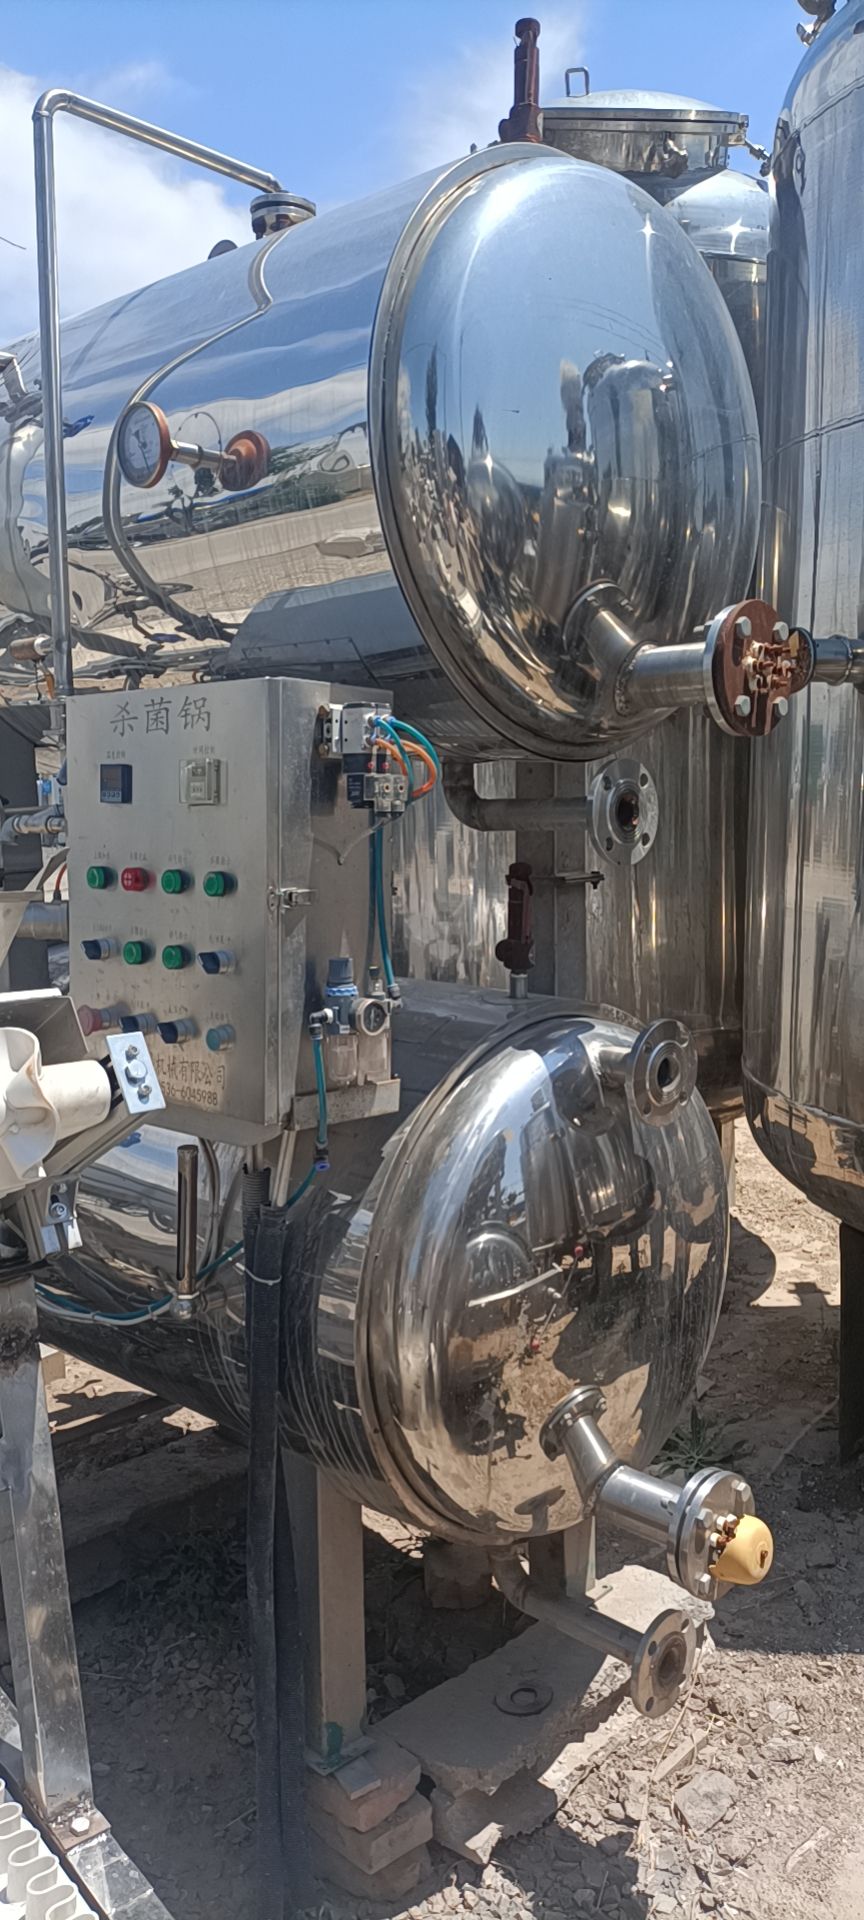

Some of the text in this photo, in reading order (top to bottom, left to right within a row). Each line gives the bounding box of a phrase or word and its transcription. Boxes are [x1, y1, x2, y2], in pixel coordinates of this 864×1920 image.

[110, 696, 210, 737] 杀菌锅
[156, 1053, 226, 1091] 机械有限公司
